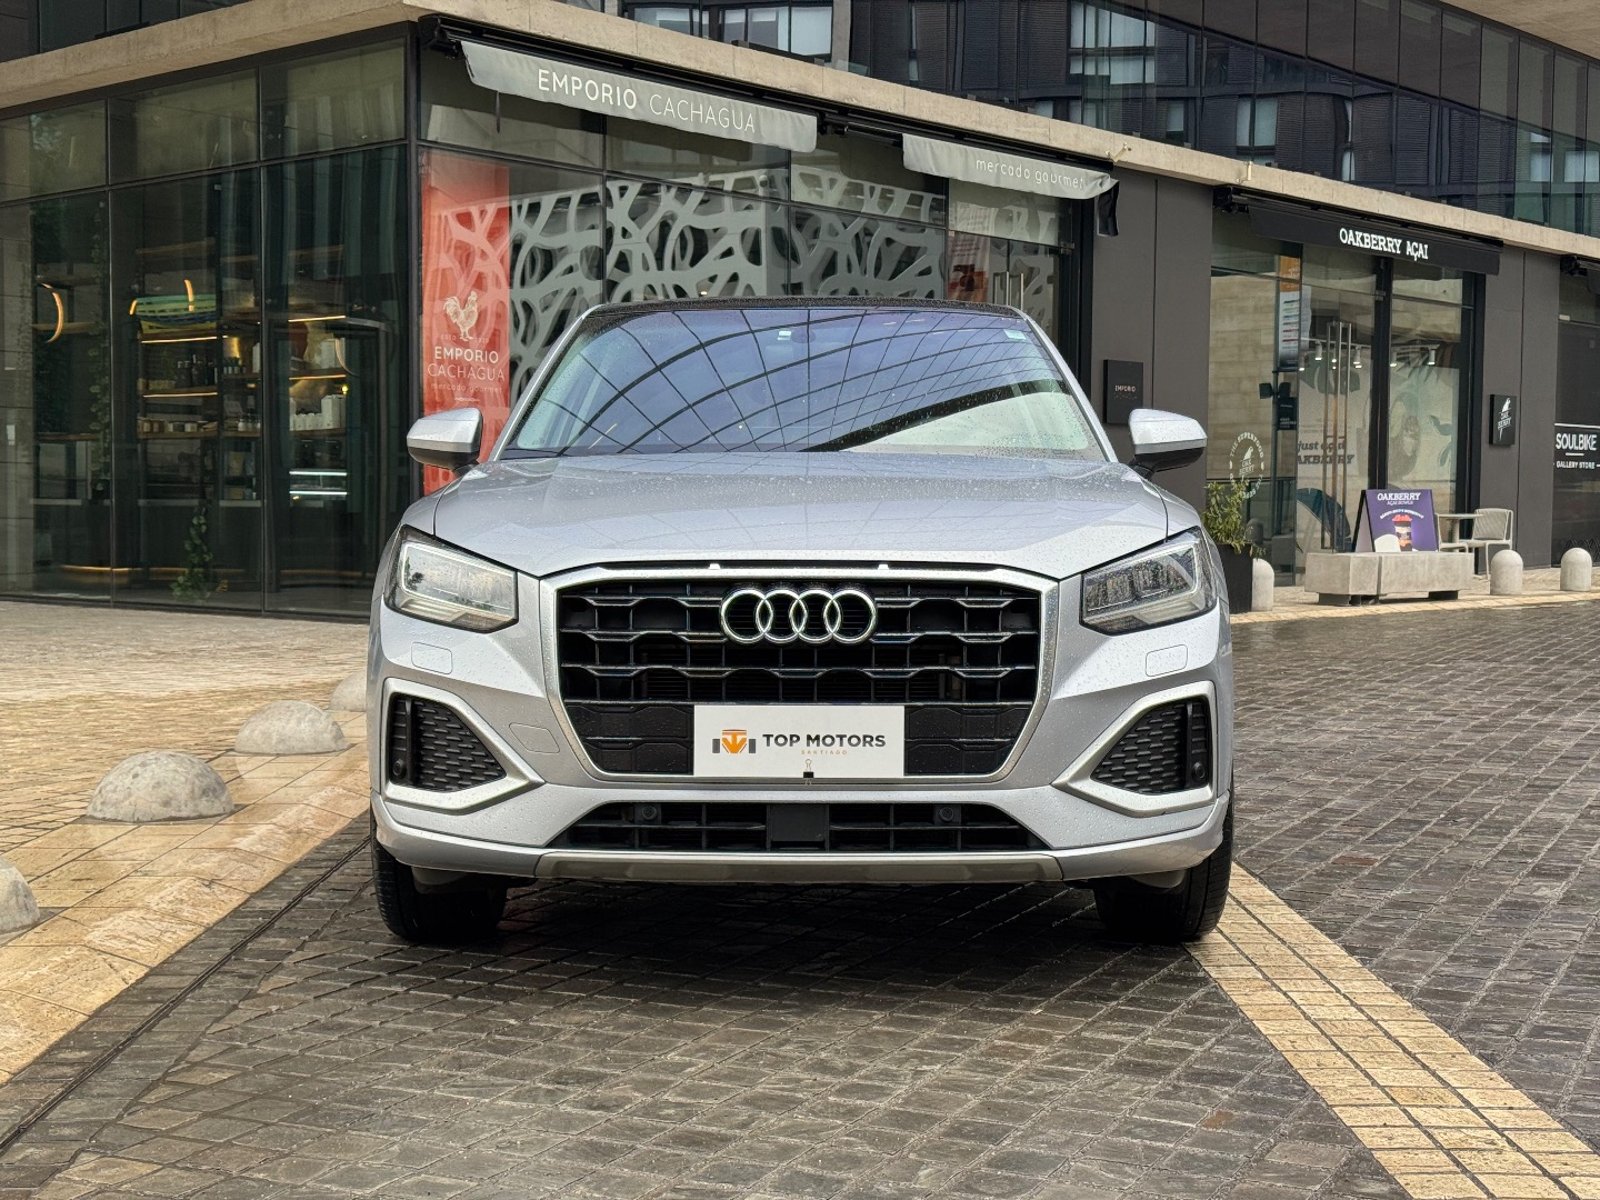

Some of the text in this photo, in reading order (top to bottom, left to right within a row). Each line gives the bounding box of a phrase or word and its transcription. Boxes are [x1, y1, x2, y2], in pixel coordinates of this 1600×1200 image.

[538, 68, 755, 134] EMPORIO CACHAGUA
[976, 160, 1083, 189] mercado gourmet
[1339, 227, 1429, 261] OAKBERRY AÇAI
[434, 345, 499, 364] EMPORIO
[427, 362, 505, 382] CACHAGUA
[1555, 432, 1597, 451] SOULBIKE
[1556, 460, 1595, 469] GALLERY STORE
[1377, 492, 1421, 501] OAKBERRY
[762, 733, 886, 748] TOP MOTORS
